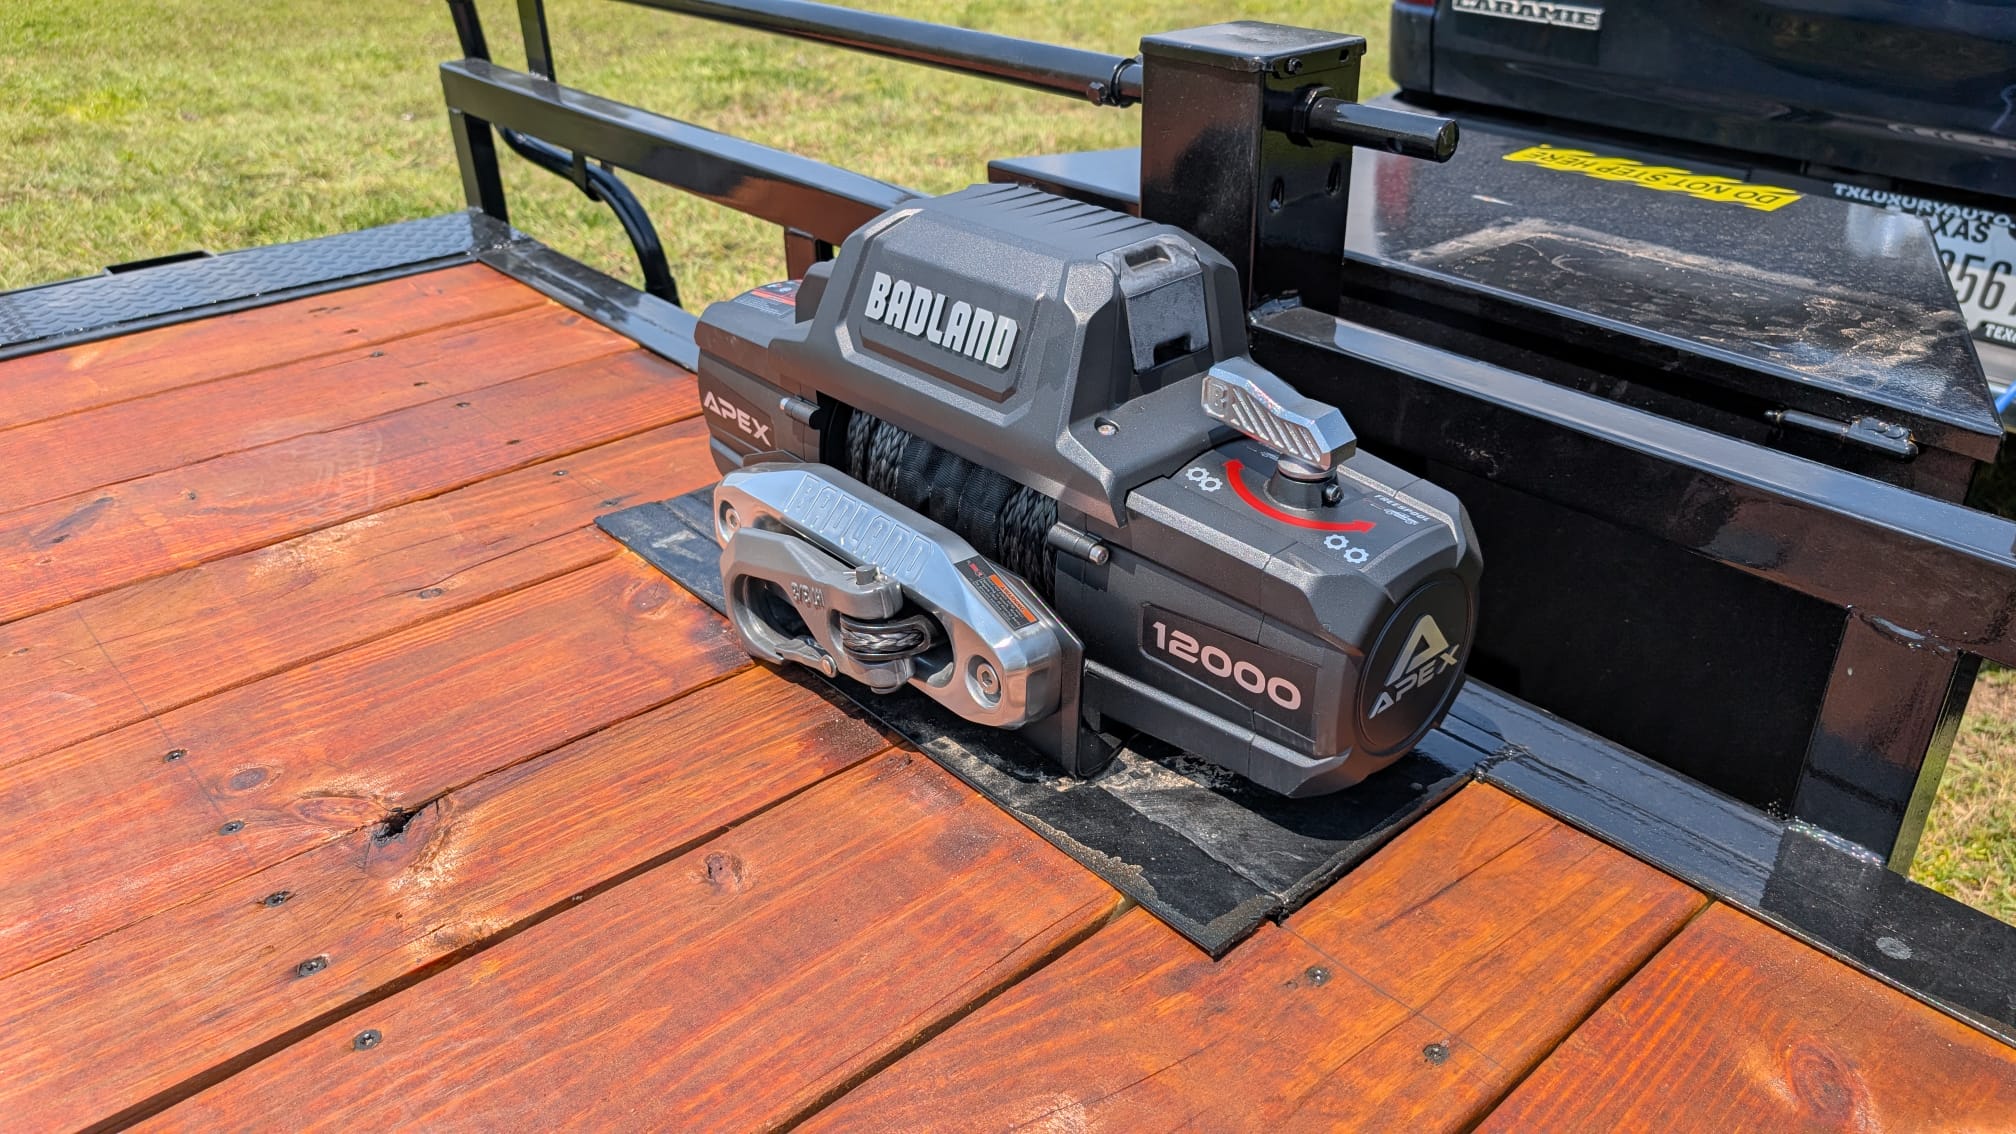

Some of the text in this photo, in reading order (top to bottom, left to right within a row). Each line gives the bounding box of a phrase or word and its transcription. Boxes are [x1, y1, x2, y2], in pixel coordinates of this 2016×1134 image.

[1527, 150, 1780, 205] DO NOT STEP HERE
[1933, 206, 1990, 243] XAS
[1940, 249, 2016, 316] 56
[864, 271, 1019, 369] BADLAND
[704, 391, 771, 447] APEX
[784, 472, 932, 584] BADLAND
[1152, 620, 1301, 710] 12000
[1368, 643, 1460, 720] APEX
